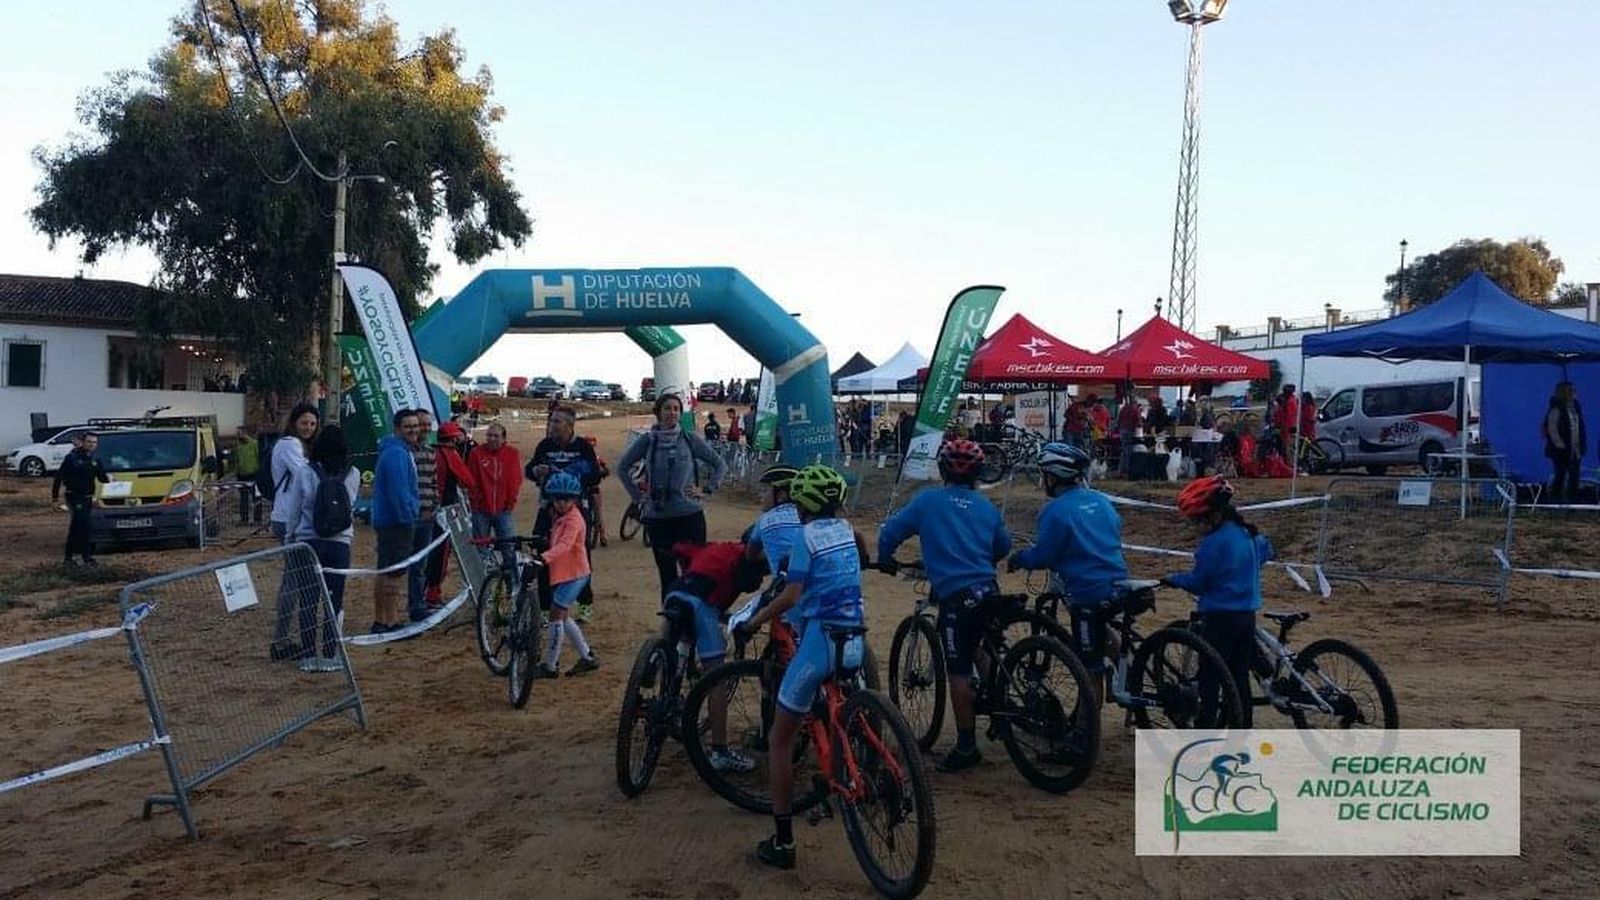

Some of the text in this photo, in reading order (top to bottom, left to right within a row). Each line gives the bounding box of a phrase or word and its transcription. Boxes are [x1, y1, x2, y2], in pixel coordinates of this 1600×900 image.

[582, 272, 702, 289] DIPUTACIÓN
[585, 292, 692, 308] DE HUELVA
[1006, 363, 1105, 376] mscbikes.com
[1153, 363, 1248, 376] mscbikes.com
